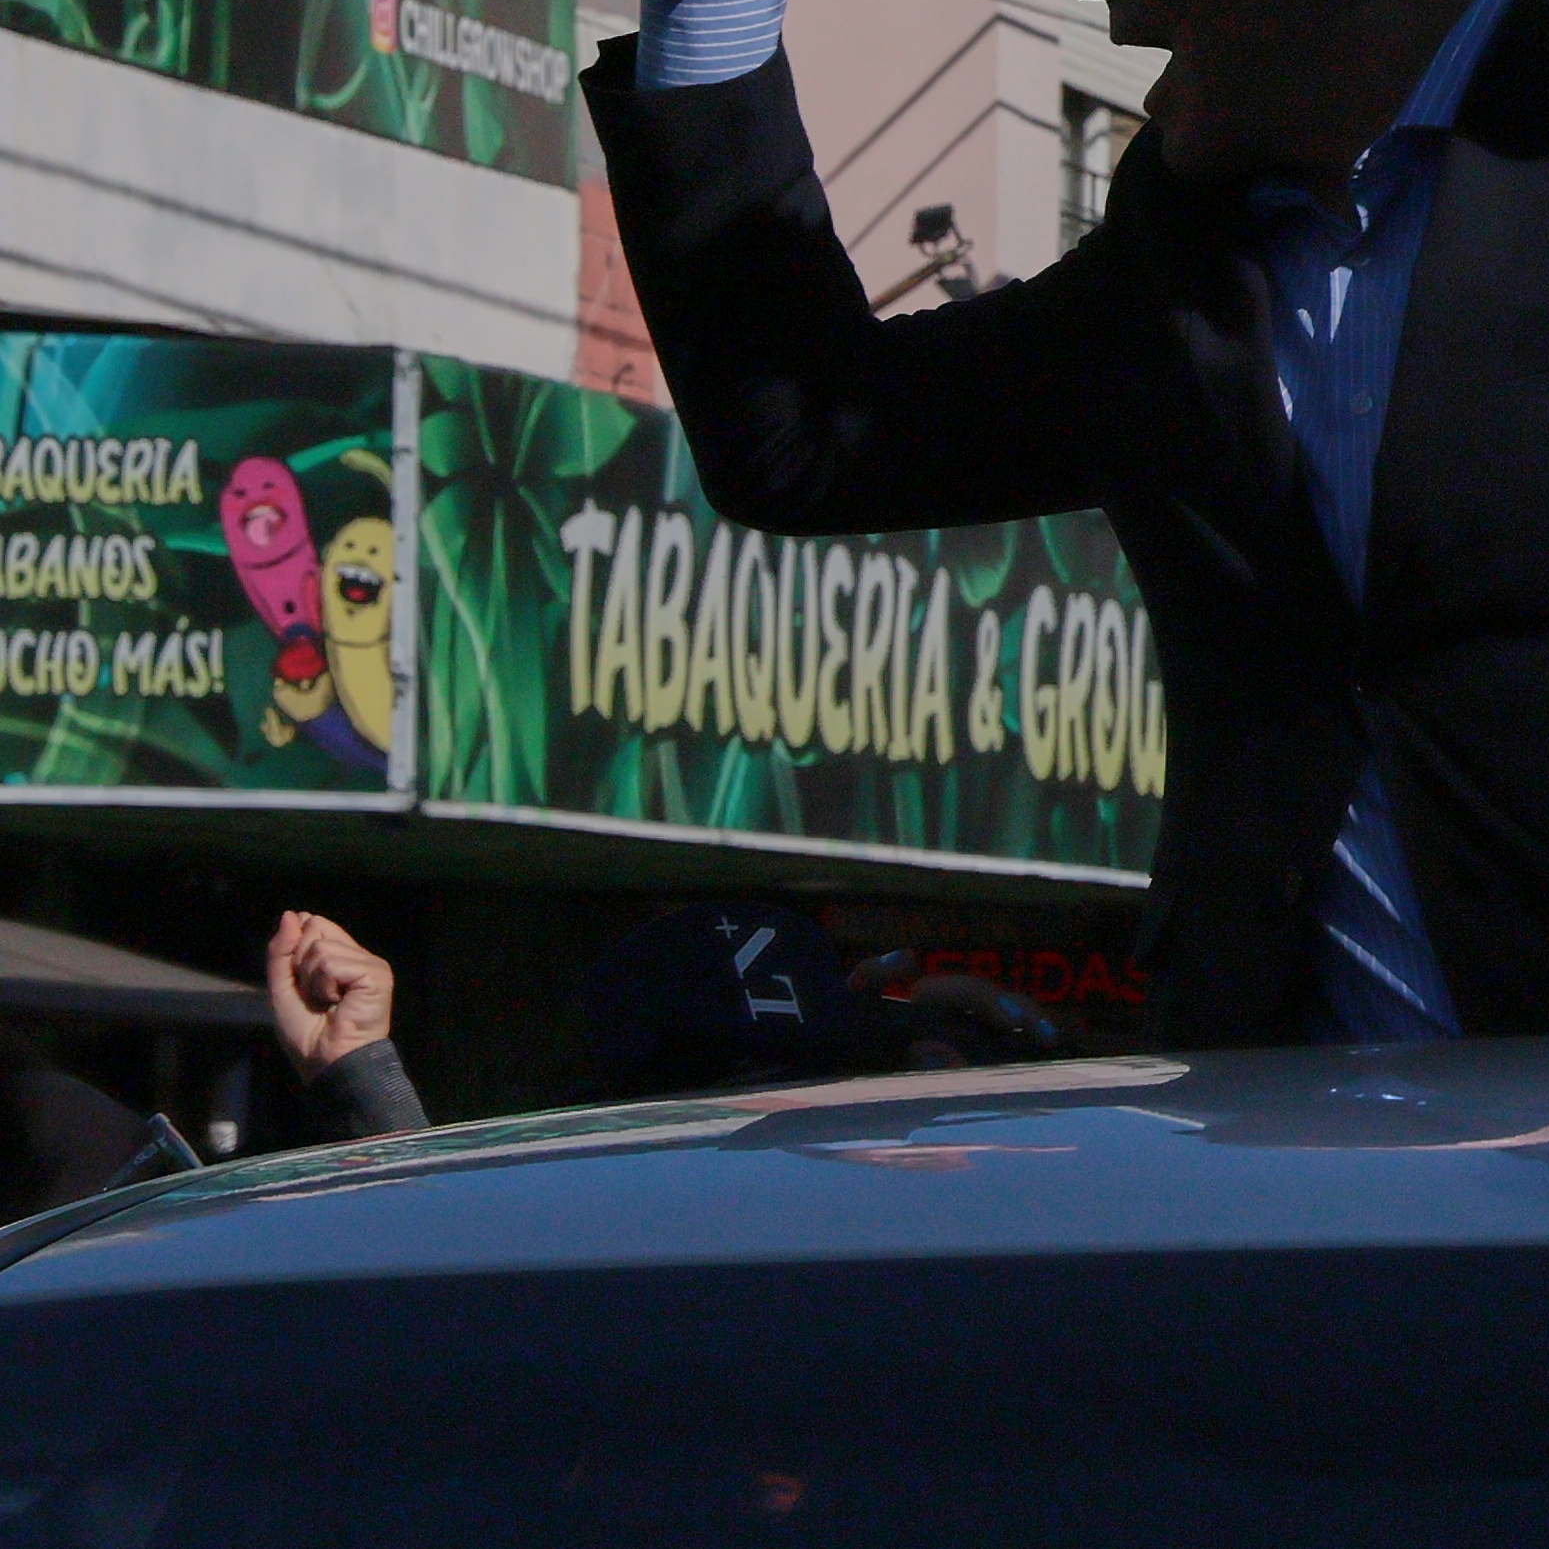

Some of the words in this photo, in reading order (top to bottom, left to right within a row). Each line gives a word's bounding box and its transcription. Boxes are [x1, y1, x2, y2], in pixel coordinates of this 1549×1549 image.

[0, 436, 203, 505] AQUERIA
[0, 531, 159, 601] BANOS
[0, 628, 100, 697] CHO
[112, 615, 226, 698] MÁS!
[560, 499, 954, 764] TABAQUERIA
[968, 609, 1002, 751] &
